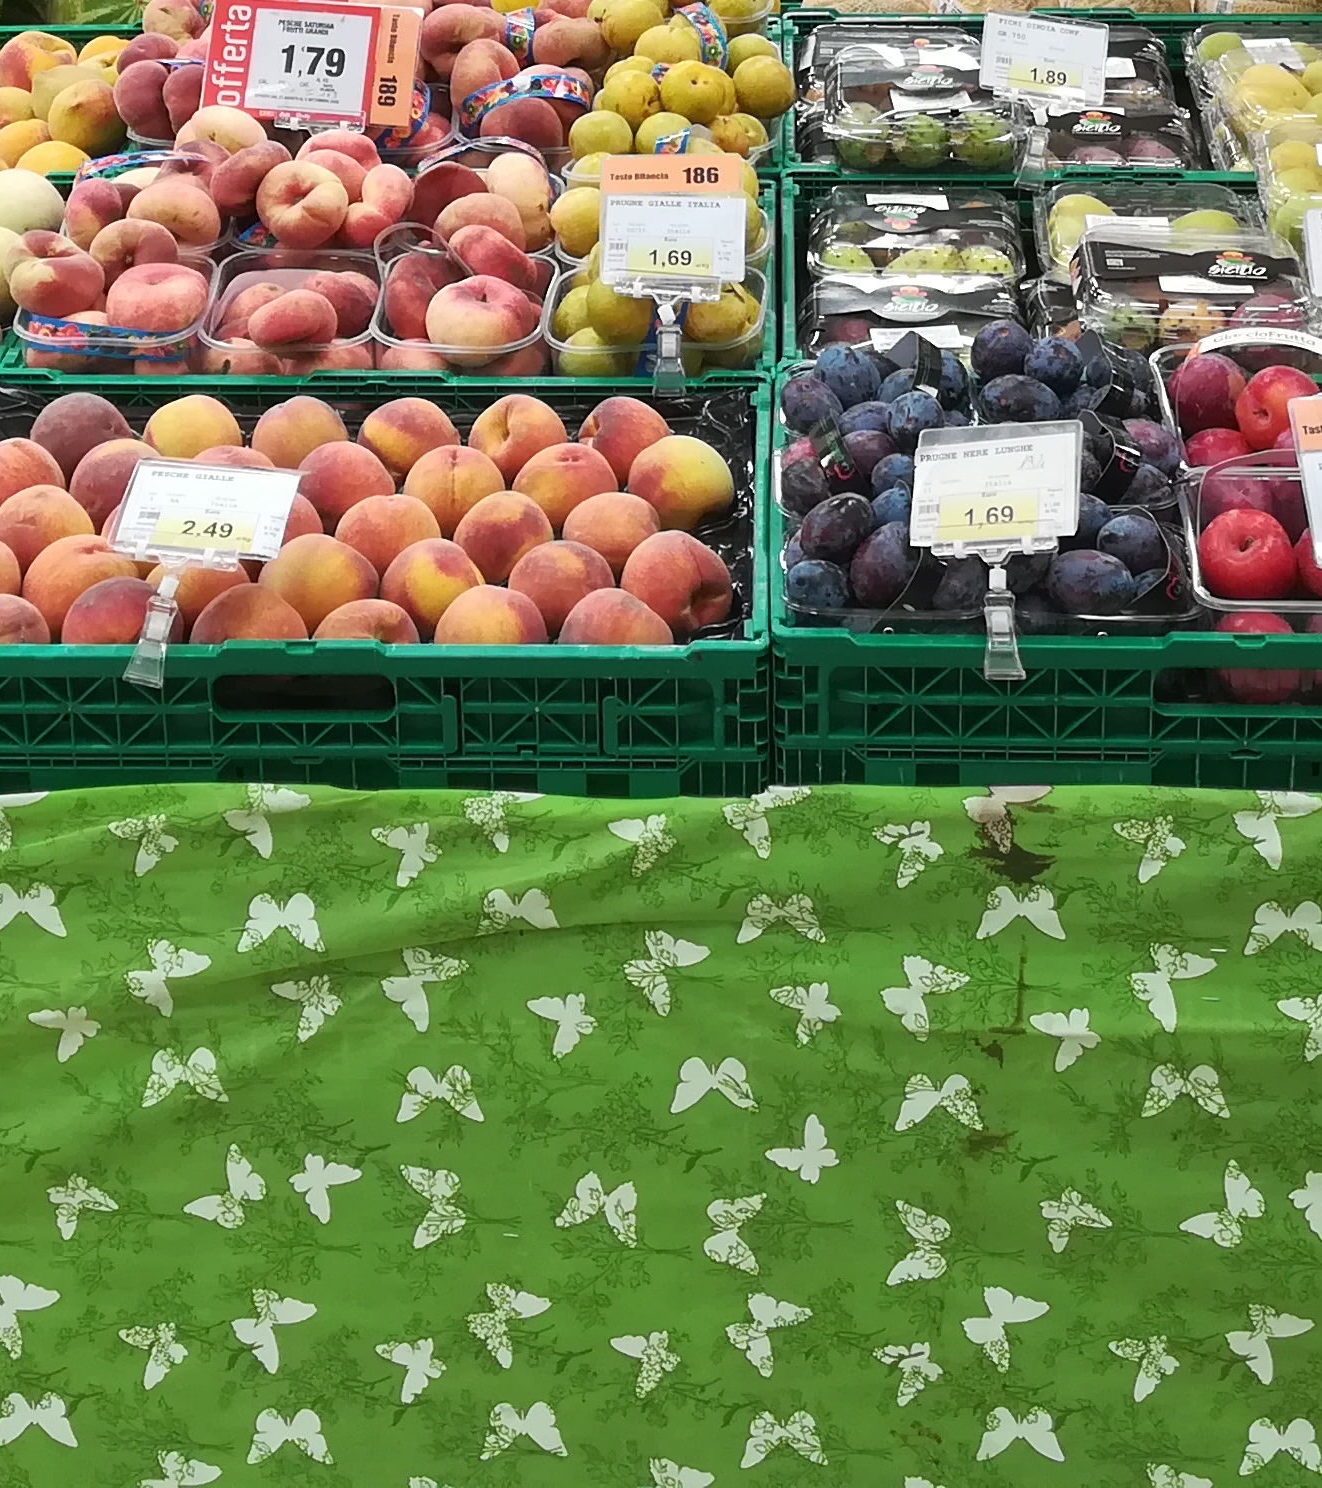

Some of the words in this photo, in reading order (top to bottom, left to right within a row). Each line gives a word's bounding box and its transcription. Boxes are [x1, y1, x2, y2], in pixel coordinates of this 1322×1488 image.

[210, 2, 254, 107] offerta
[1030, 67, 1068, 86] 1,89
[377, 75, 398, 108] 189
[682, 166, 720, 184] 186
[609, 199, 644, 208] PRUGNE
[648, 199, 684, 209] GIALLE
[687, 200, 722, 209] ITALIA
[648, 248, 693, 269] 1,69
[919, 451, 958, 464] PRUGNE
[963, 448, 989, 460] NERE
[994, 444, 1034, 456] LUNGHE
[151, 469, 190, 481] PESCHE
[195, 473, 236, 483] GIALLE
[963, 504, 1015, 530] 1,69
[180, 518, 234, 540] 2,49
